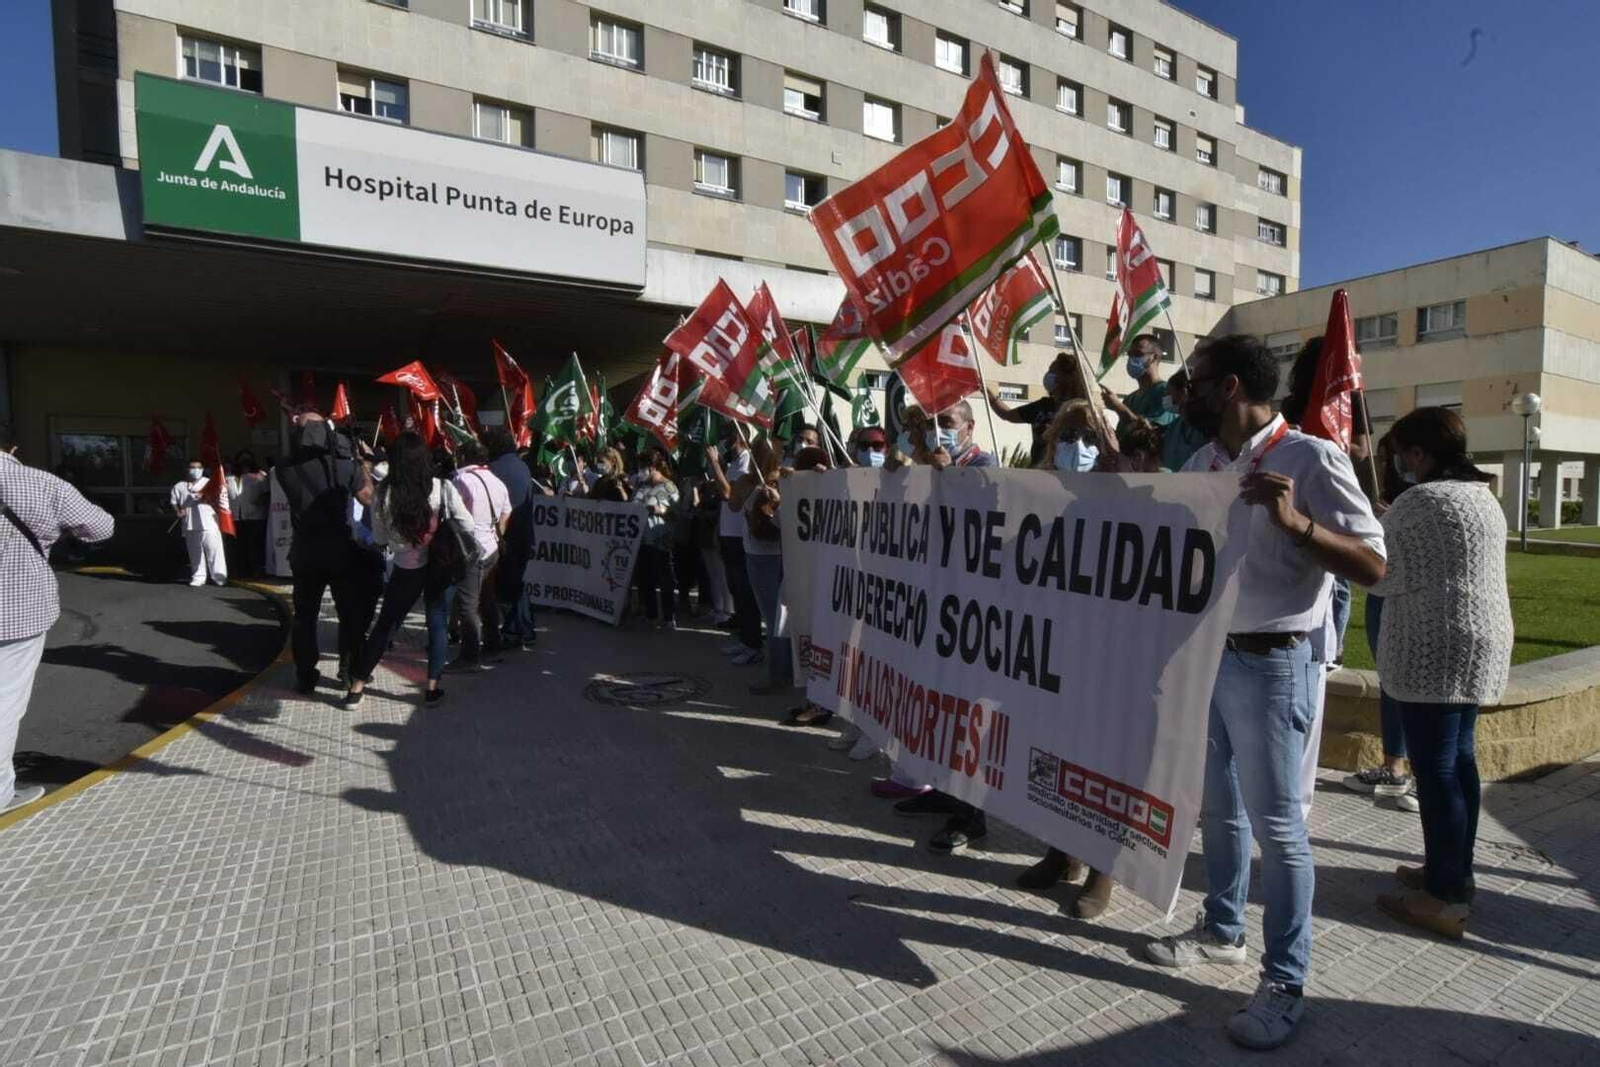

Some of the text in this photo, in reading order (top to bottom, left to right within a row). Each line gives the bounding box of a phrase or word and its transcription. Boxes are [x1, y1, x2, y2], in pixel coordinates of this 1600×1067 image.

[157, 171, 286, 200] Junta de Andalucía
[324, 166, 635, 236] Hospital Punta de Europa
[534, 504, 559, 527] OS
[525, 582, 541, 597] OS
[939, 505, 956, 568] Y
[964, 508, 1006, 580] DE
[1015, 513, 1217, 615] CALIDAD
[832, 564, 1061, 694] UN DERECHO SOCIAL
[895, 671, 983, 777] CORTES
[1027, 783, 1168, 859] sindicato de sanidad y sectores
[1064, 769, 1150, 824] CCOO
[1094, 822, 1107, 836] de
